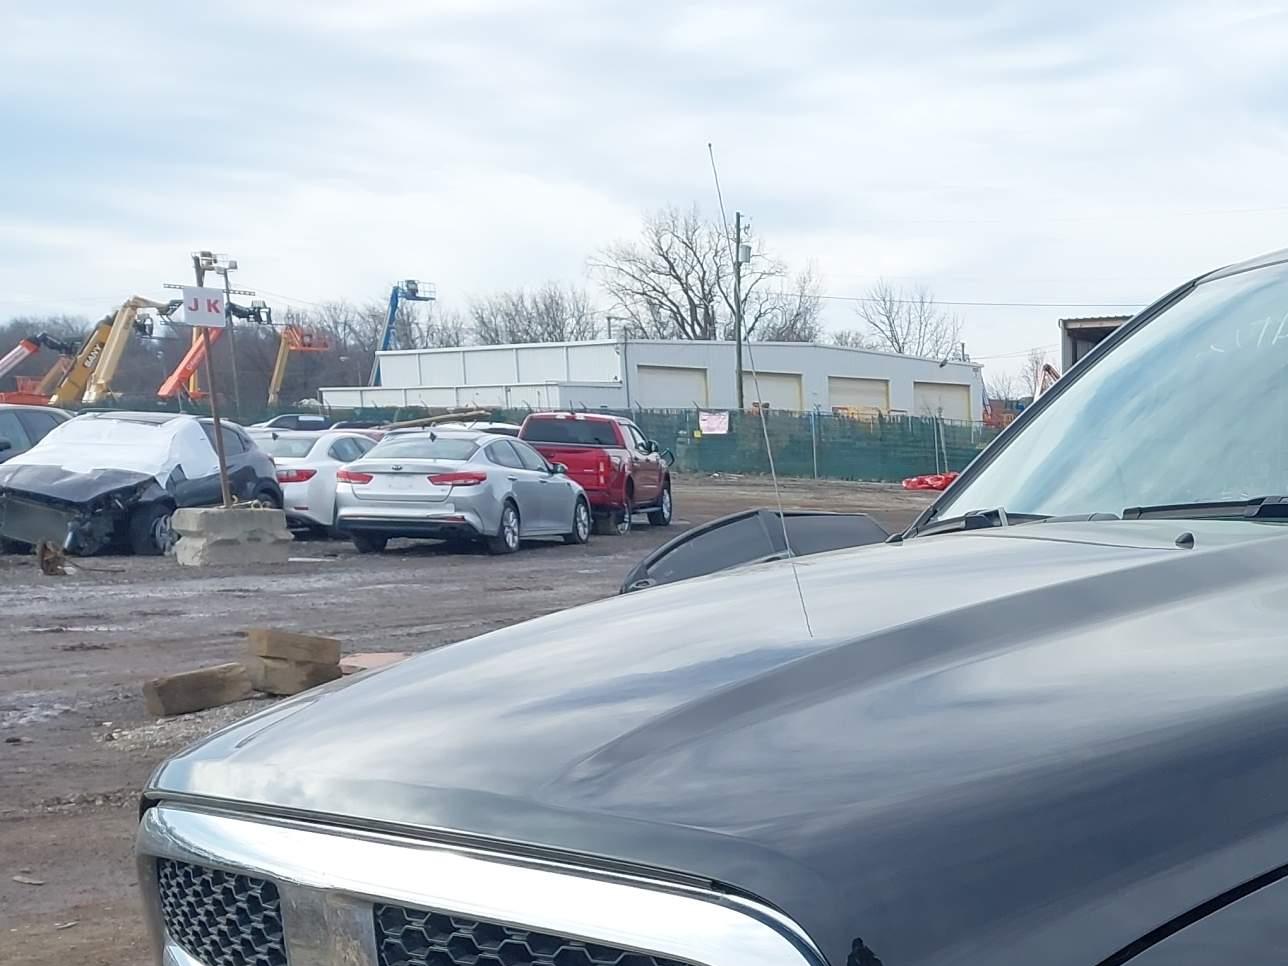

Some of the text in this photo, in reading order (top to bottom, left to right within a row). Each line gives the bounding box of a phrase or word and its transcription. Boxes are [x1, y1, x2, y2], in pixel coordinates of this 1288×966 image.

[187, 297, 221, 313] J K
[84, 344, 102, 369] SANY
